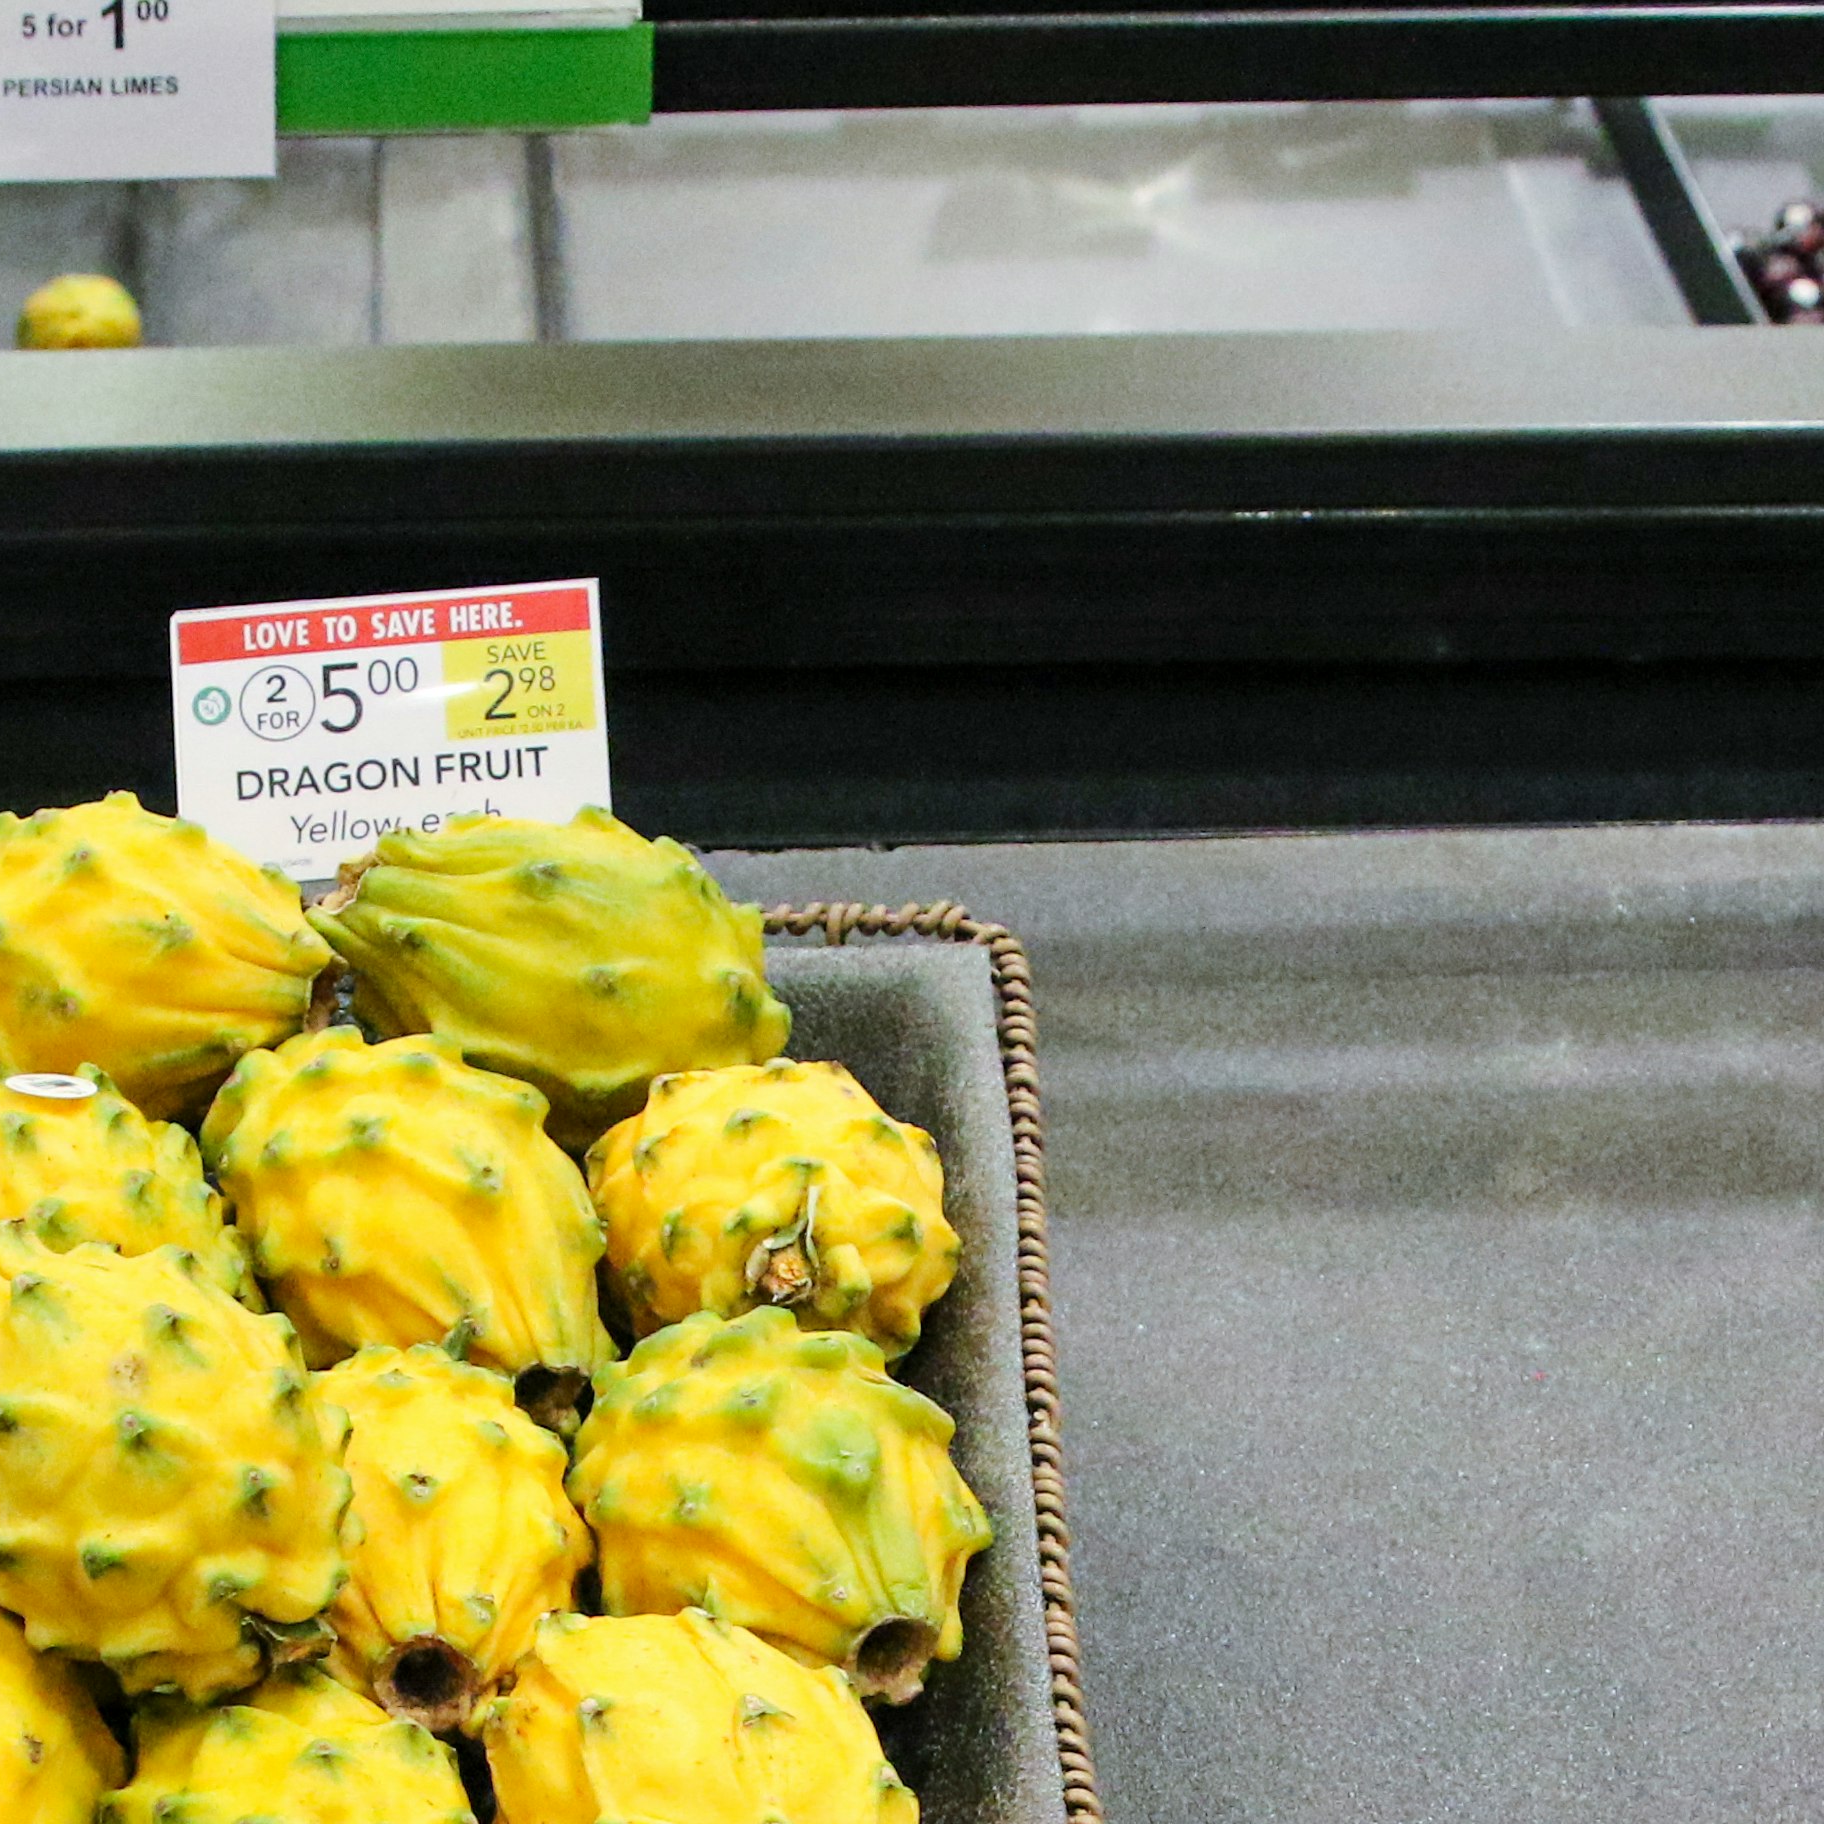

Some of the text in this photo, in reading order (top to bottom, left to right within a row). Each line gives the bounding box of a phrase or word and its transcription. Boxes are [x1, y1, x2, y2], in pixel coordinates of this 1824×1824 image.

[22, 14, 37, 38] 5
[46, 12, 87, 37] for
[2, 75, 179, 97] PERSIAN LIMES
[242, 601, 524, 651] LOVE TO SAVE HERE.
[486, 640, 547, 664] SAVE
[266, 674, 287, 704] 2
[257, 710, 301, 731] FOR
[527, 703, 565, 719] ON 2
[236, 745, 549, 801] DRAGON FRUIT
